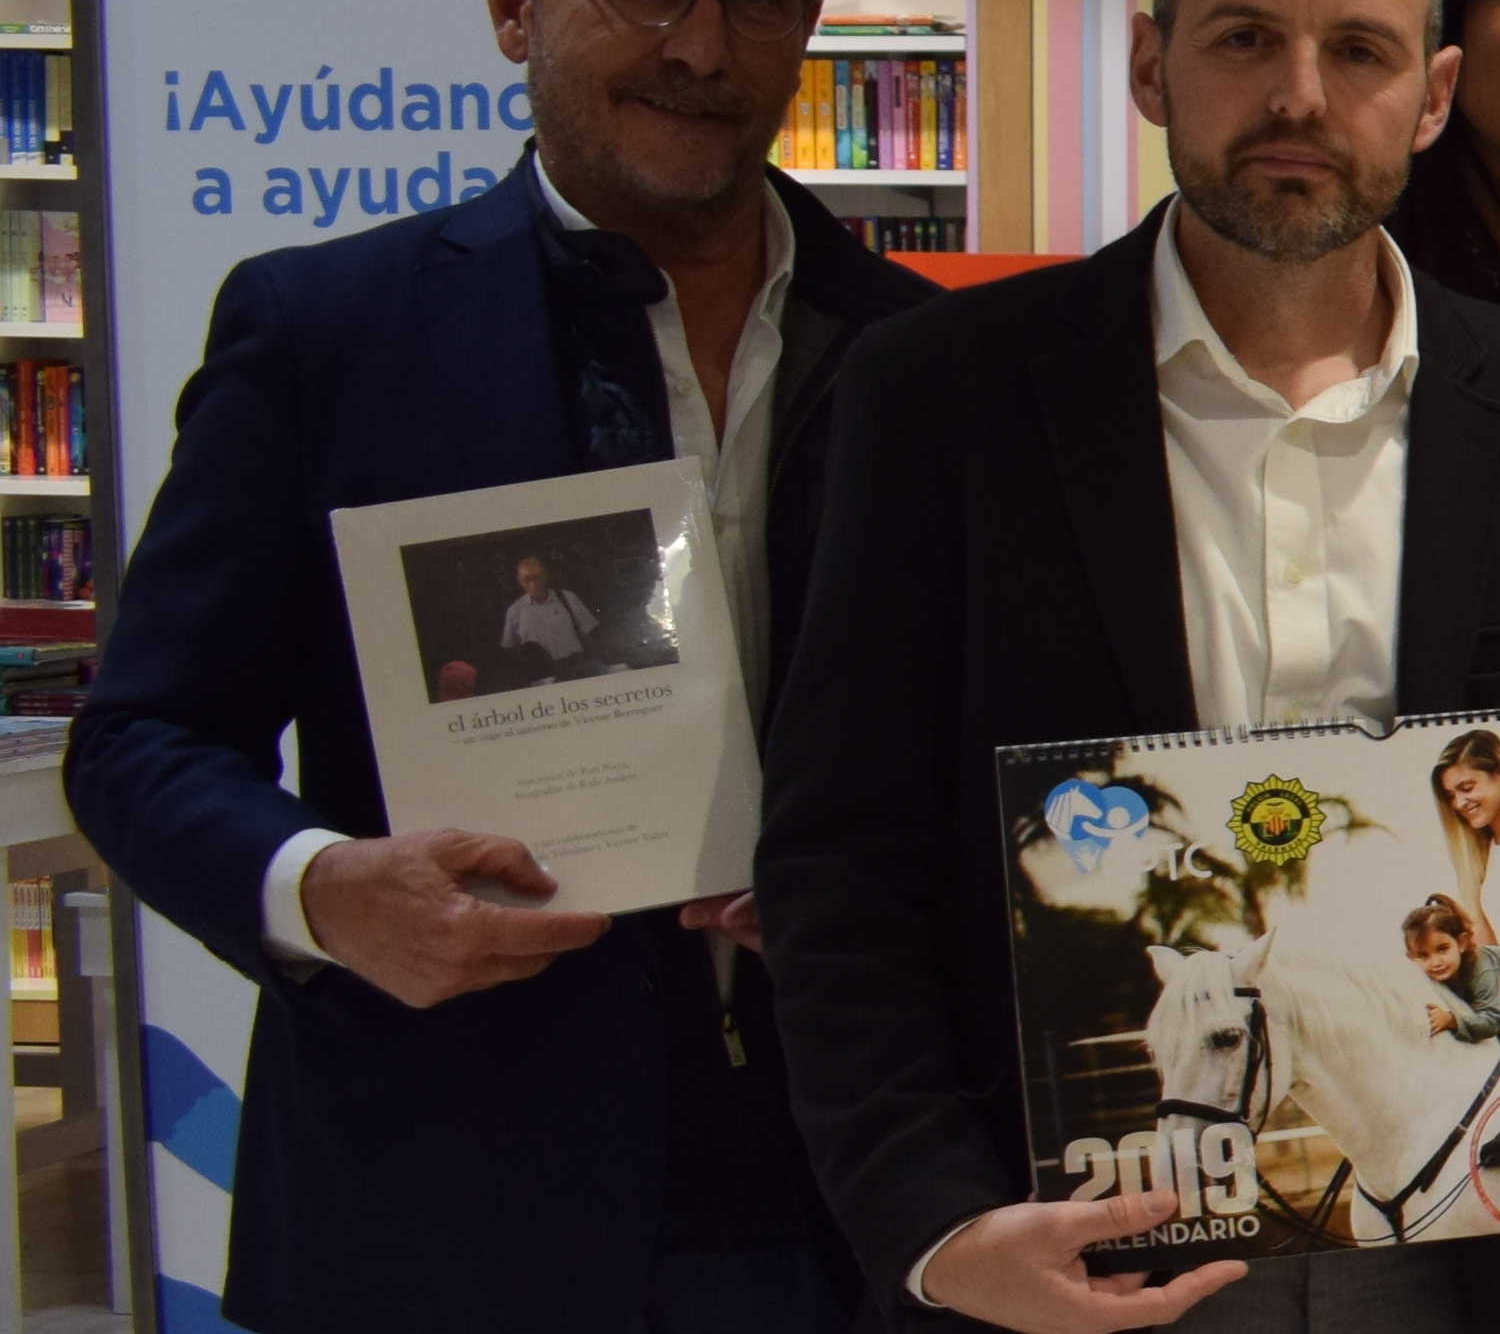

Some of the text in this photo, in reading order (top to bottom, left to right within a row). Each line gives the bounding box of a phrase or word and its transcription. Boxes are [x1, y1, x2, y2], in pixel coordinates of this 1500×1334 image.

[163, 66, 534, 145] ¡Ayúdano
[191, 151, 510, 229] a ayuda
[447, 683, 674, 734] el árbol de los secretos
